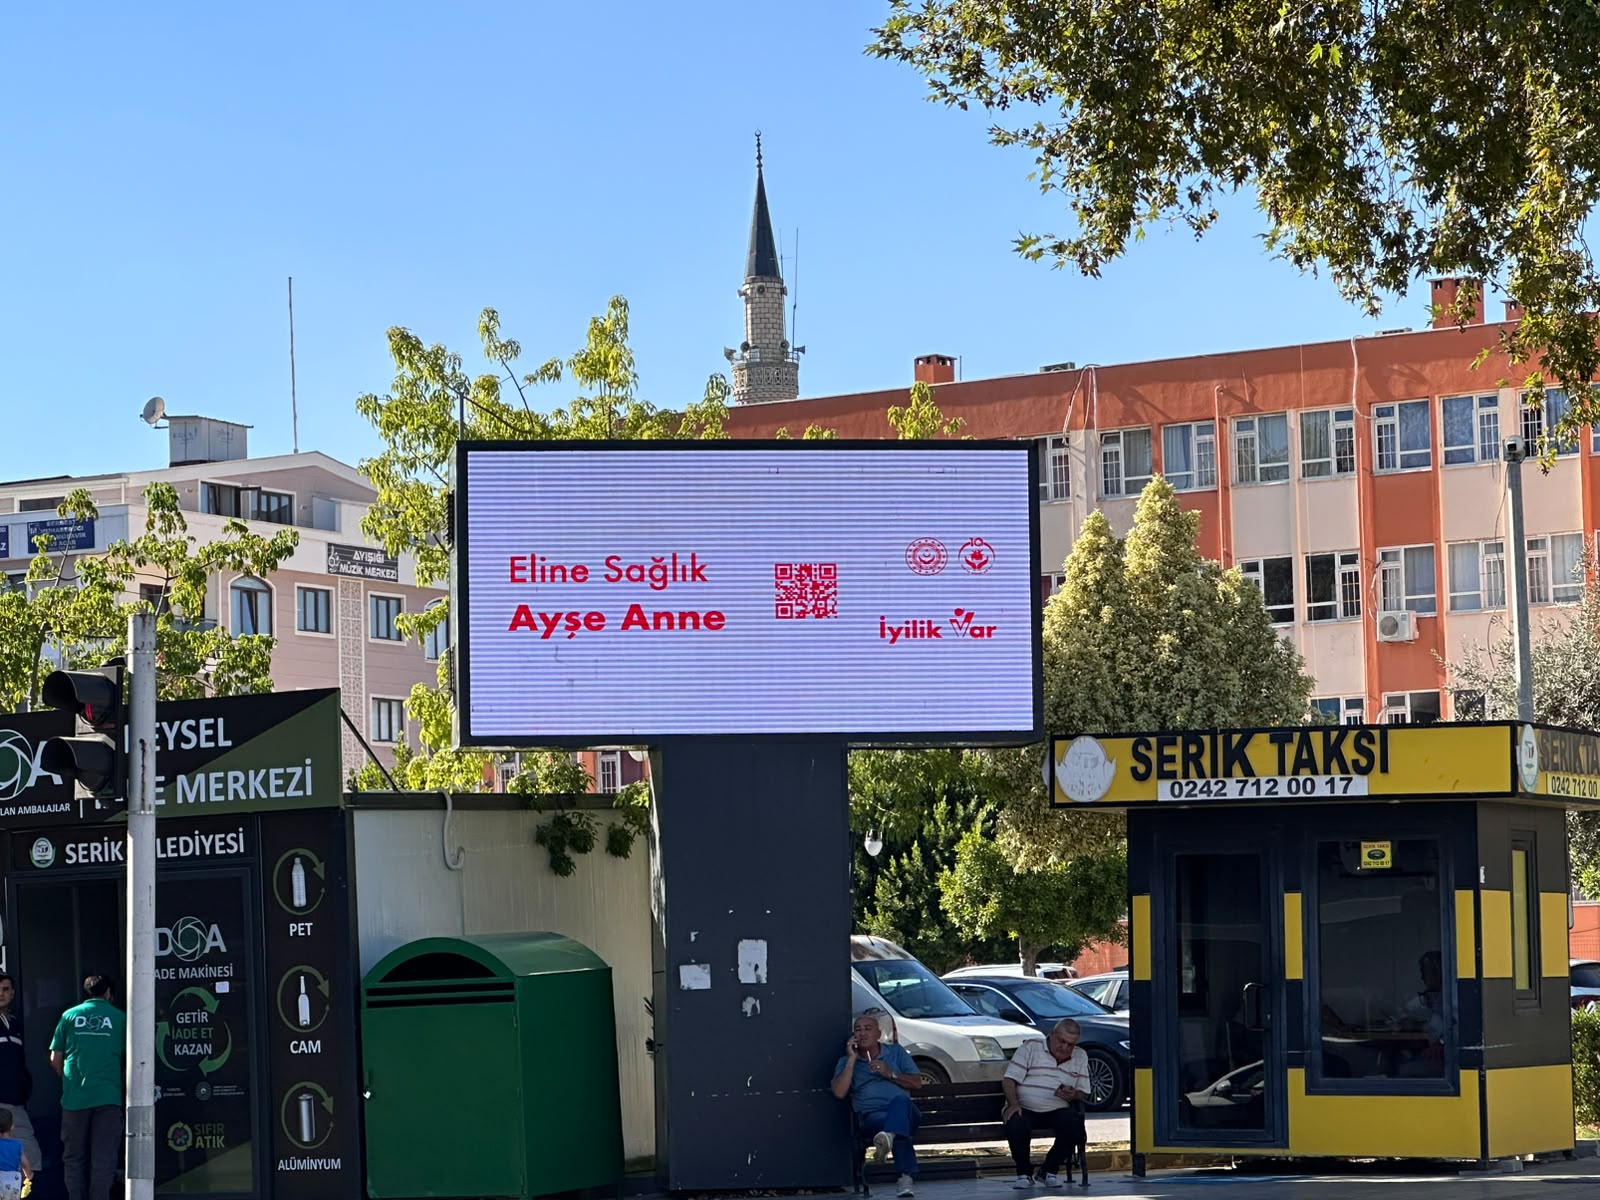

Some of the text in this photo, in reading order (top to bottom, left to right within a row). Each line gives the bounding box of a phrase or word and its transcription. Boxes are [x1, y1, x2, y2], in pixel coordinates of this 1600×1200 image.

[339, 561, 363, 575] MÜZİK
[509, 552, 708, 591] Eline Sağlık
[508, 604, 726, 640] Ayşe Anne
[879, 607, 997, 644] İyilik Var
[124, 717, 233, 754] YSEL
[176, 757, 313, 805] MERKEZİ
[1170, 776, 1354, 798] 0242 712 00 17
[1551, 775, 1598, 798] 0242 712 00
[18, 802, 71, 815] AMBALAJLAR
[65, 827, 244, 864] SERİK LEDİYESİ
[289, 922, 314, 937] PET
[154, 963, 234, 980] ADE MAKİNESİ
[176, 1009, 208, 1024] GETİR
[201, 1027, 214, 1039] ET
[174, 1043, 212, 1056] KAZAN
[289, 1040, 321, 1054] CAM
[194, 1122, 225, 1136] SIFIR
[195, 1135, 225, 1149] ATIK
[277, 1156, 341, 1171] ALÜMİNYUM
